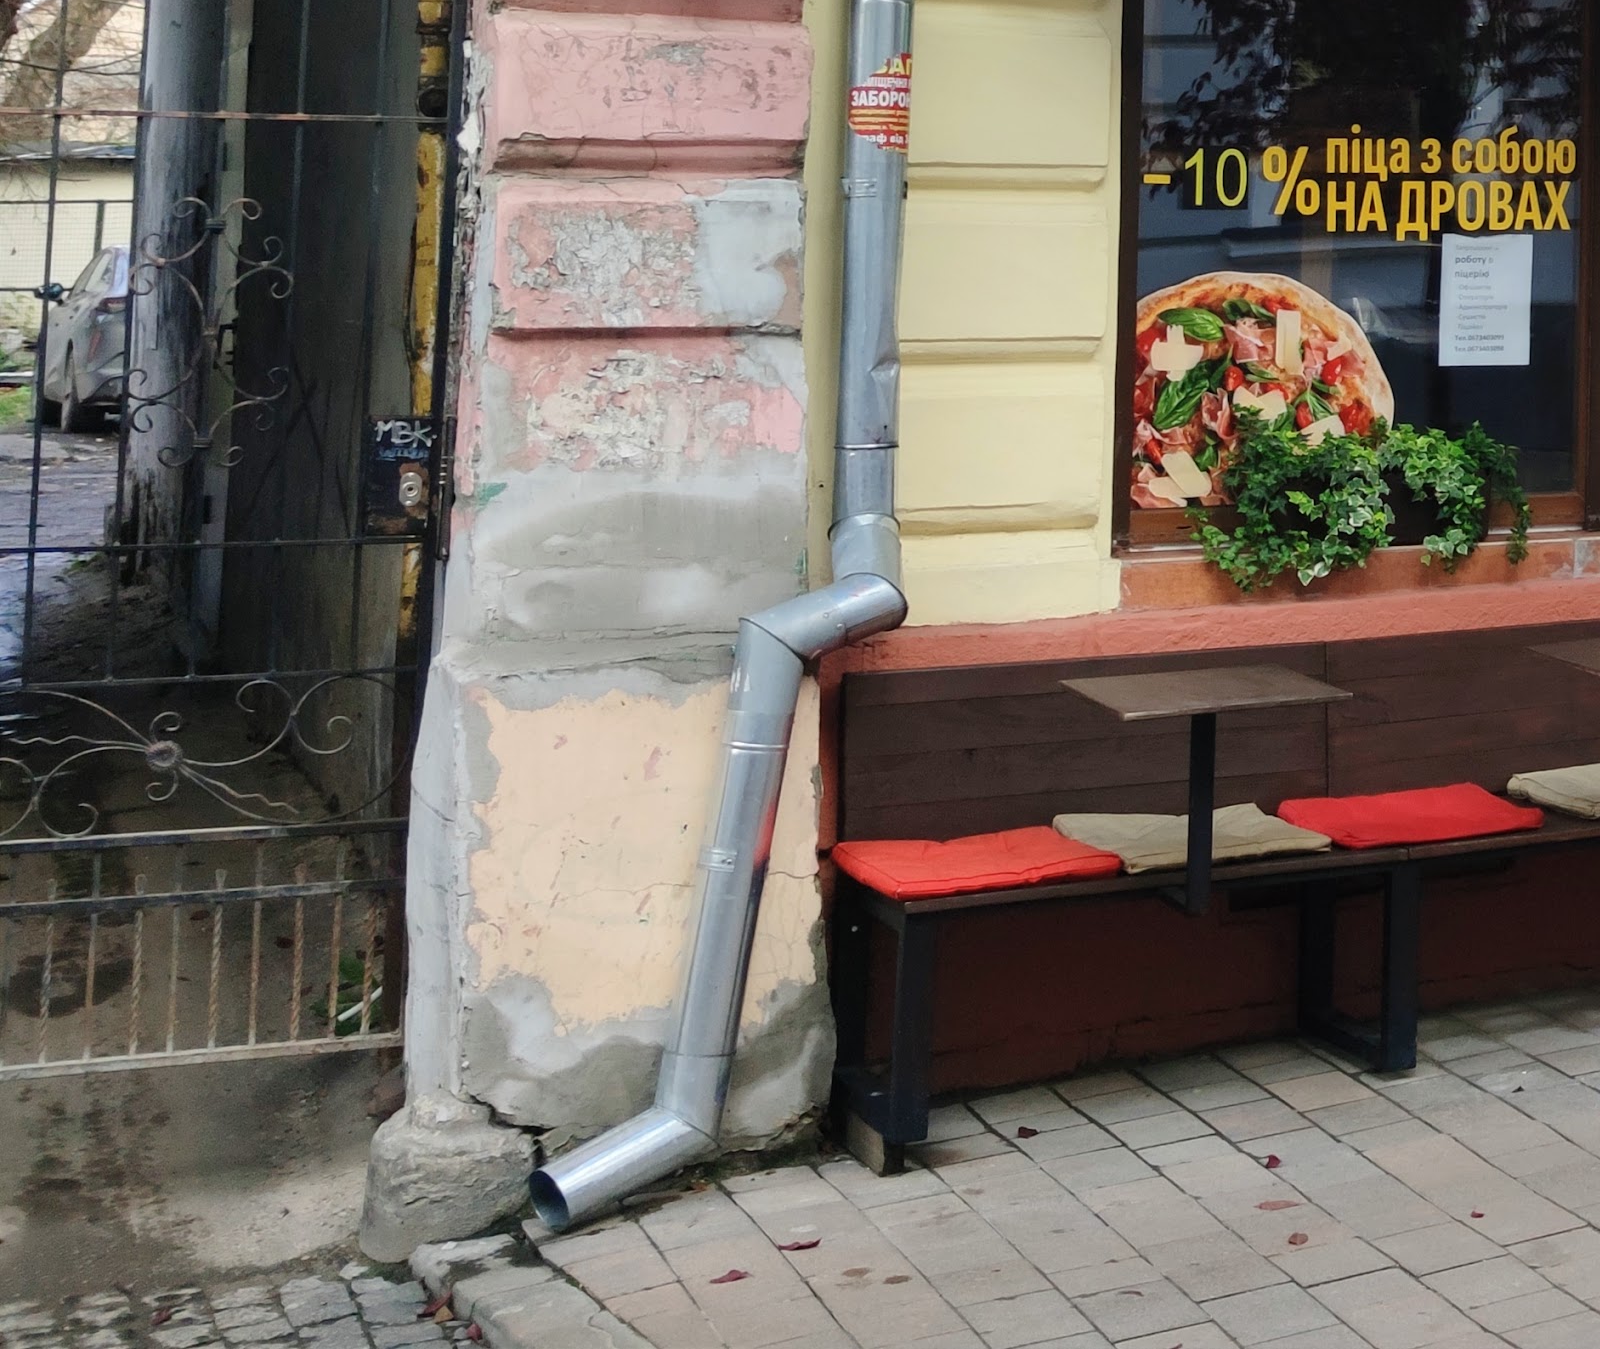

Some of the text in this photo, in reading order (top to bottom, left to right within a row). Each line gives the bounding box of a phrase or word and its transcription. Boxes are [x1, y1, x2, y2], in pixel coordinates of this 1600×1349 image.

[1326, 124, 1576, 182] піца з собою
[1326, 180, 1571, 241] НА ДРОВАХ
[1455, 255, 1487, 264] роботу
